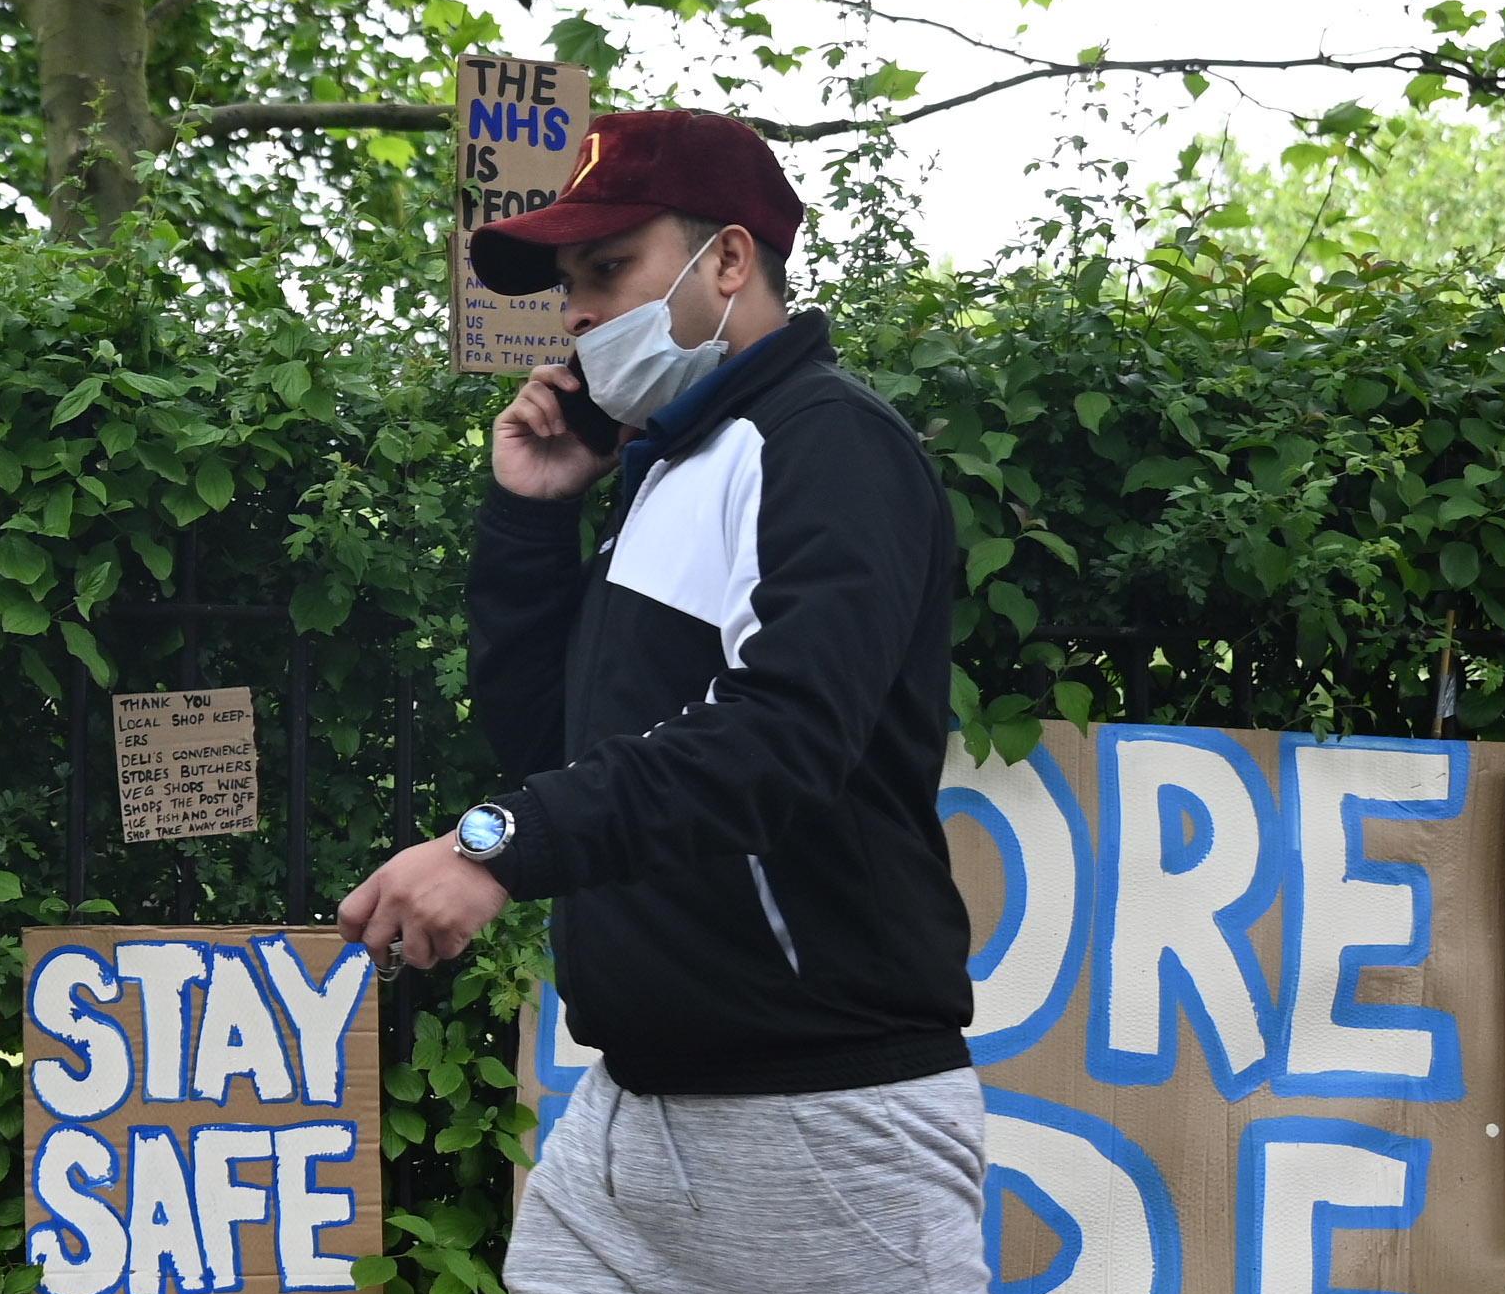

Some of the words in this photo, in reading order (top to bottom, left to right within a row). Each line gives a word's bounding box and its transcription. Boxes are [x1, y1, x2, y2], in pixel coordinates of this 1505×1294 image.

[466, 60, 557, 106] THE
[469, 99, 569, 151] NHS
[466, 144, 498, 183] IS
[466, 298, 497, 309] WILL
[510, 299, 549, 311] LOOK
[466, 316, 483, 329] US
[465, 350, 492, 363] FOR
[500, 351, 534, 365] THE
[120, 697, 171, 712] THANK
[183, 695, 211, 708] YOU
[119, 716, 160, 732] LOCAL
[172, 714, 204, 727] SHOP
[173, 744, 252, 760] CONVENIENCE
[181, 760, 252, 778] BUTCHERS
[122, 786, 153, 800] VEG
[164, 781, 204, 795] SHOPS
[218, 777, 254, 790] WINE
[123, 800, 162, 817] SHOPS
[170, 797, 193, 809] THE
[199, 793, 228, 804] POST
[182, 810, 207, 822] AND
[215, 804, 244, 817] CHIP
[155, 825, 182, 837] TAKE
[189, 822, 216, 832] AWAY
[220, 815, 254, 830] COFFEE
[28, 932, 375, 1123] STAY
